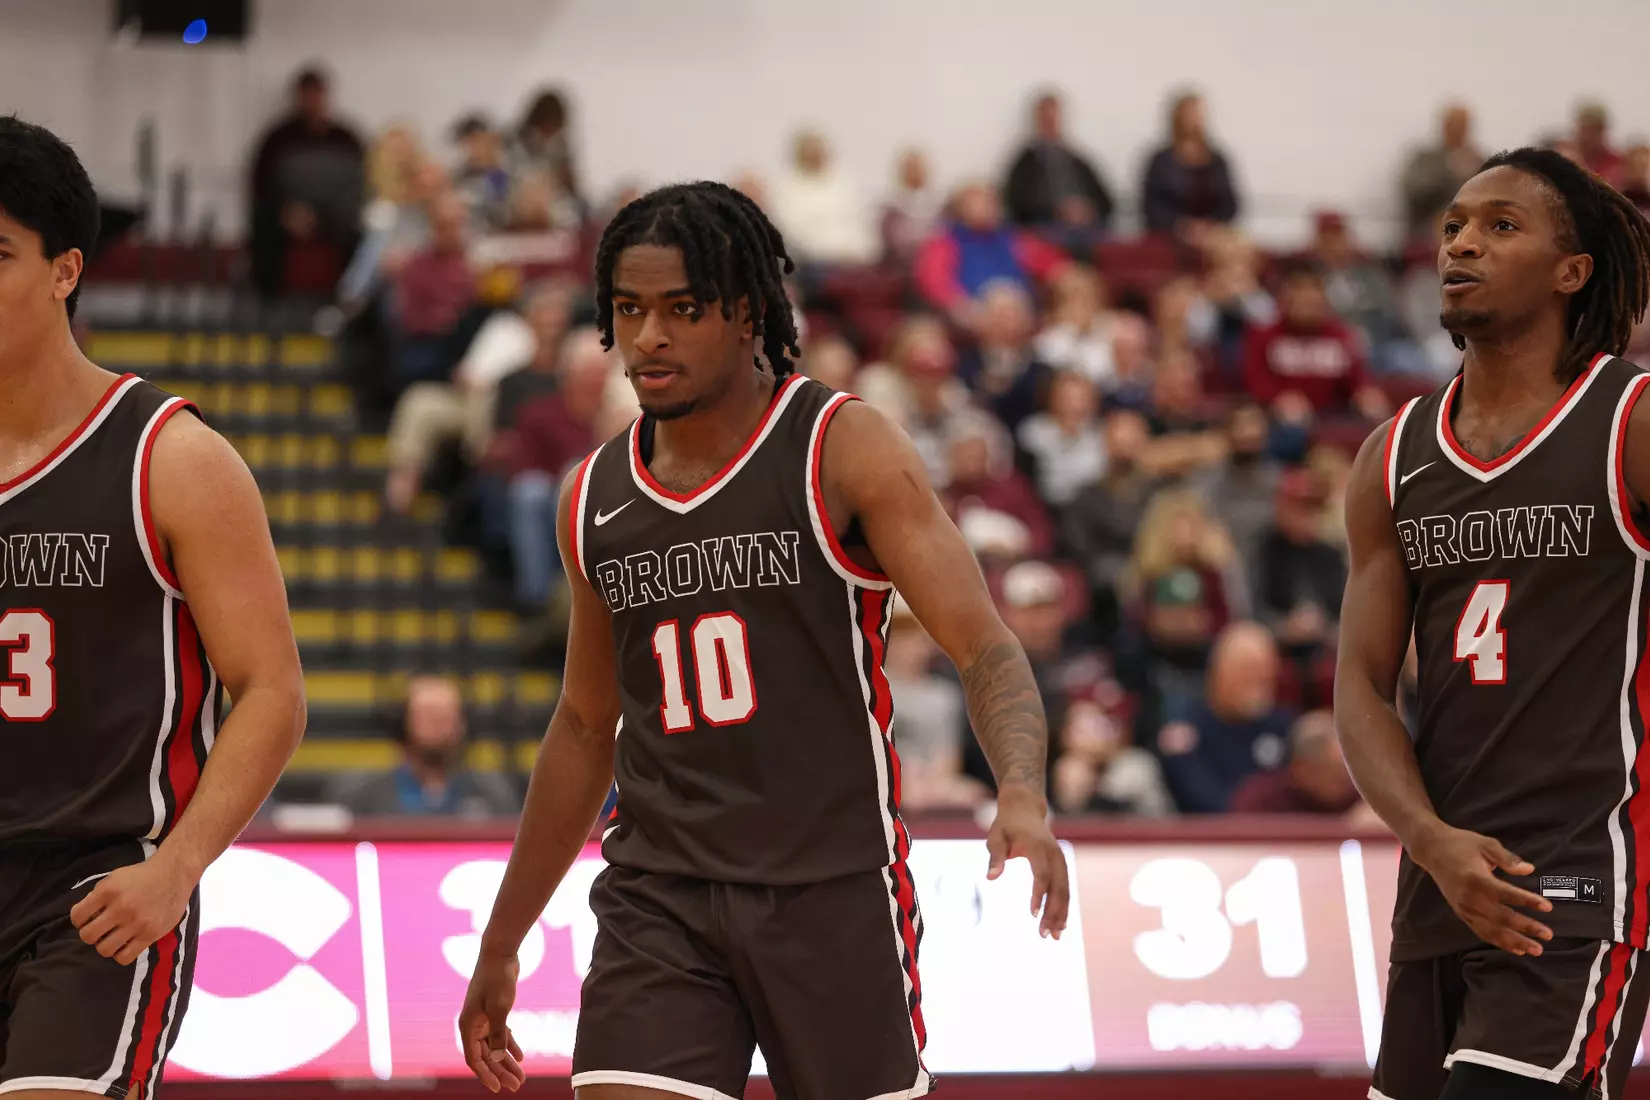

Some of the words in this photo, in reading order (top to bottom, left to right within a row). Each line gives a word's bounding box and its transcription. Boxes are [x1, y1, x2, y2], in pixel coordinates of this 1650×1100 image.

[0, 533, 110, 588] WN
[596, 531, 801, 613] BROWN
[1397, 505, 1594, 570] BROWN
[651, 611, 758, 735] 10
[1453, 579, 1510, 685] 4
[1129, 858, 1307, 979] 31
[1584, 884, 1595, 896] M
